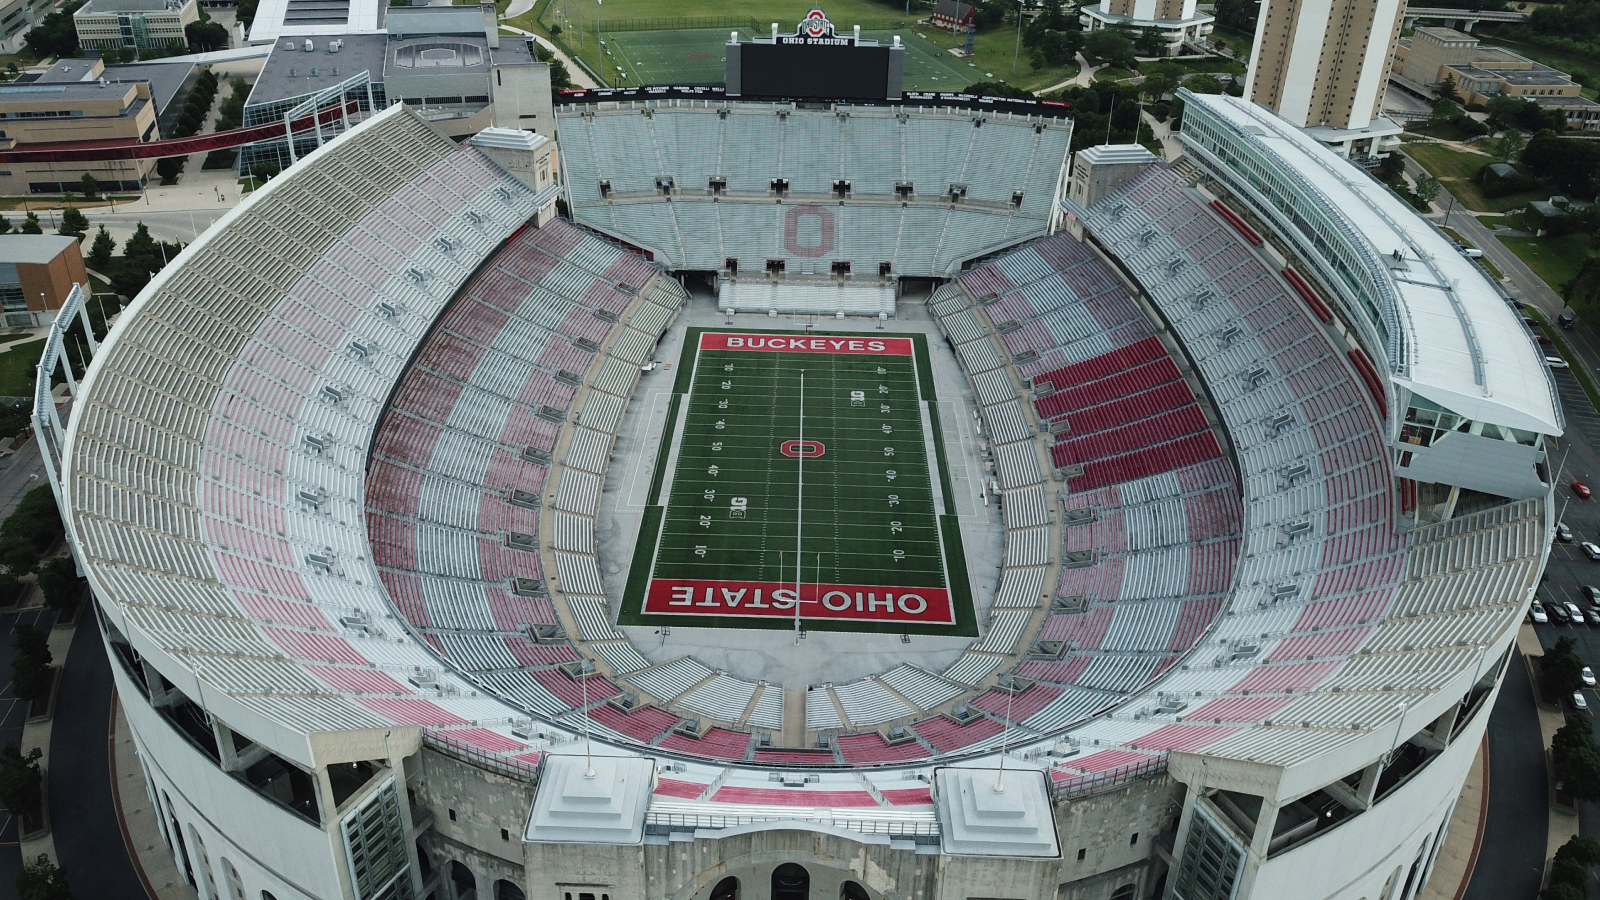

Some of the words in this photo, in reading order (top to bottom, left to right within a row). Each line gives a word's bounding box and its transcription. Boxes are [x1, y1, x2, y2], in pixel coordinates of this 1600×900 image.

[727, 337, 886, 351] BUCKEYES
[712, 442, 722, 451] 50
[781, 440, 825, 457] O
[884, 447, 894, 456] 50
[708, 465, 719, 474] 40
[704, 489, 715, 499] 30
[888, 495, 899, 505] 30
[700, 515, 711, 526] 20
[890, 521, 902, 532] 20
[695, 545, 707, 554] 10
[893, 550, 905, 559] 10
[668, 586, 799, 609] STATE
[822, 590, 928, 614] OHIO
